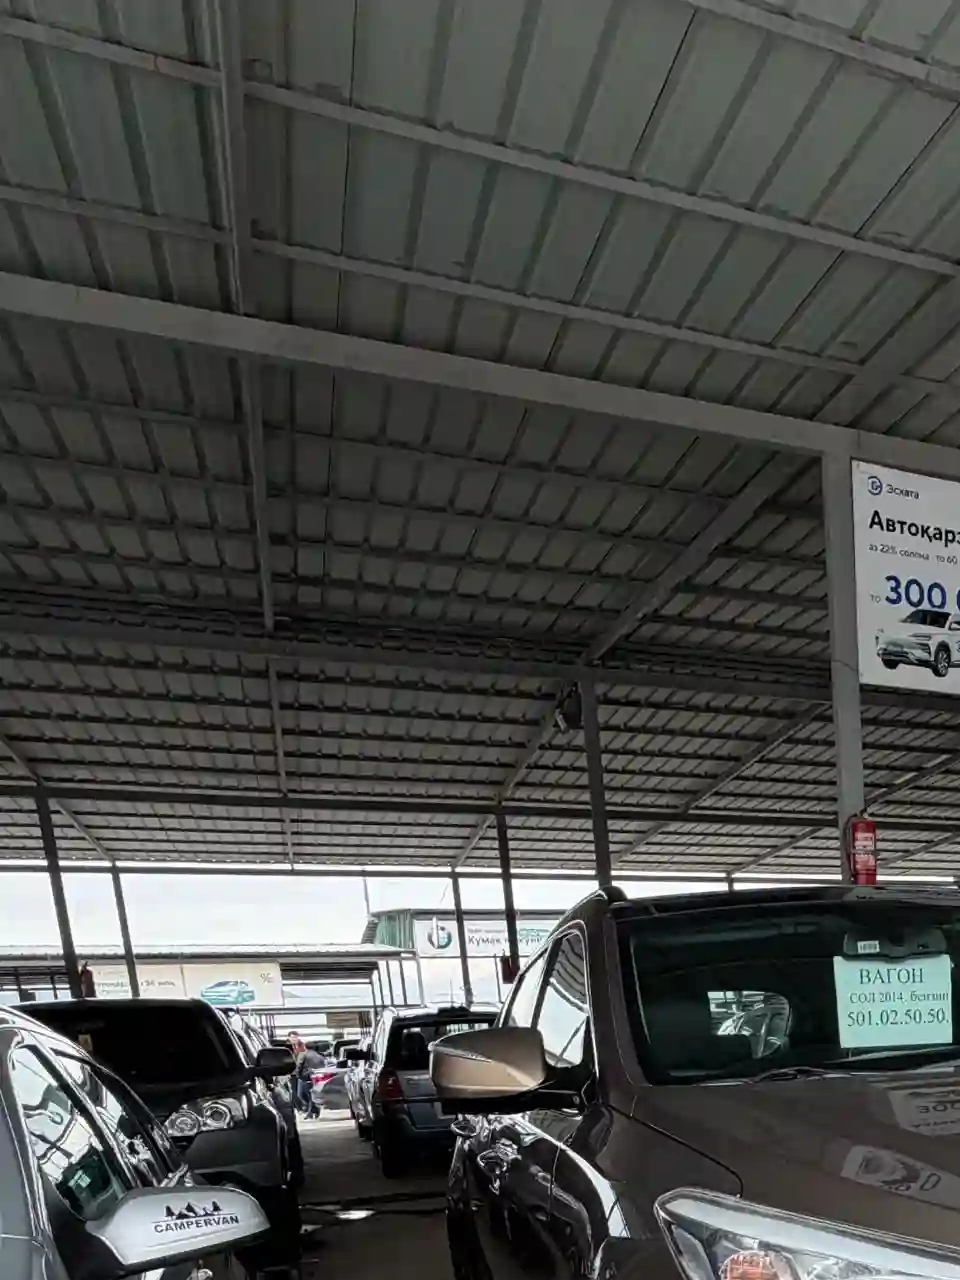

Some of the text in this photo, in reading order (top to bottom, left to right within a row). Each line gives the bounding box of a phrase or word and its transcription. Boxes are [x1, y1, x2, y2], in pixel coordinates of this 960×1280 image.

[885, 483, 920, 500] Эсхата
[870, 593, 881, 604] то
[885, 575, 947, 609] 300
[859, 968, 924, 985] ВАГОН
[849, 992, 875, 1004] СОЛ
[154, 1216, 240, 1233] CAMPERVAN
